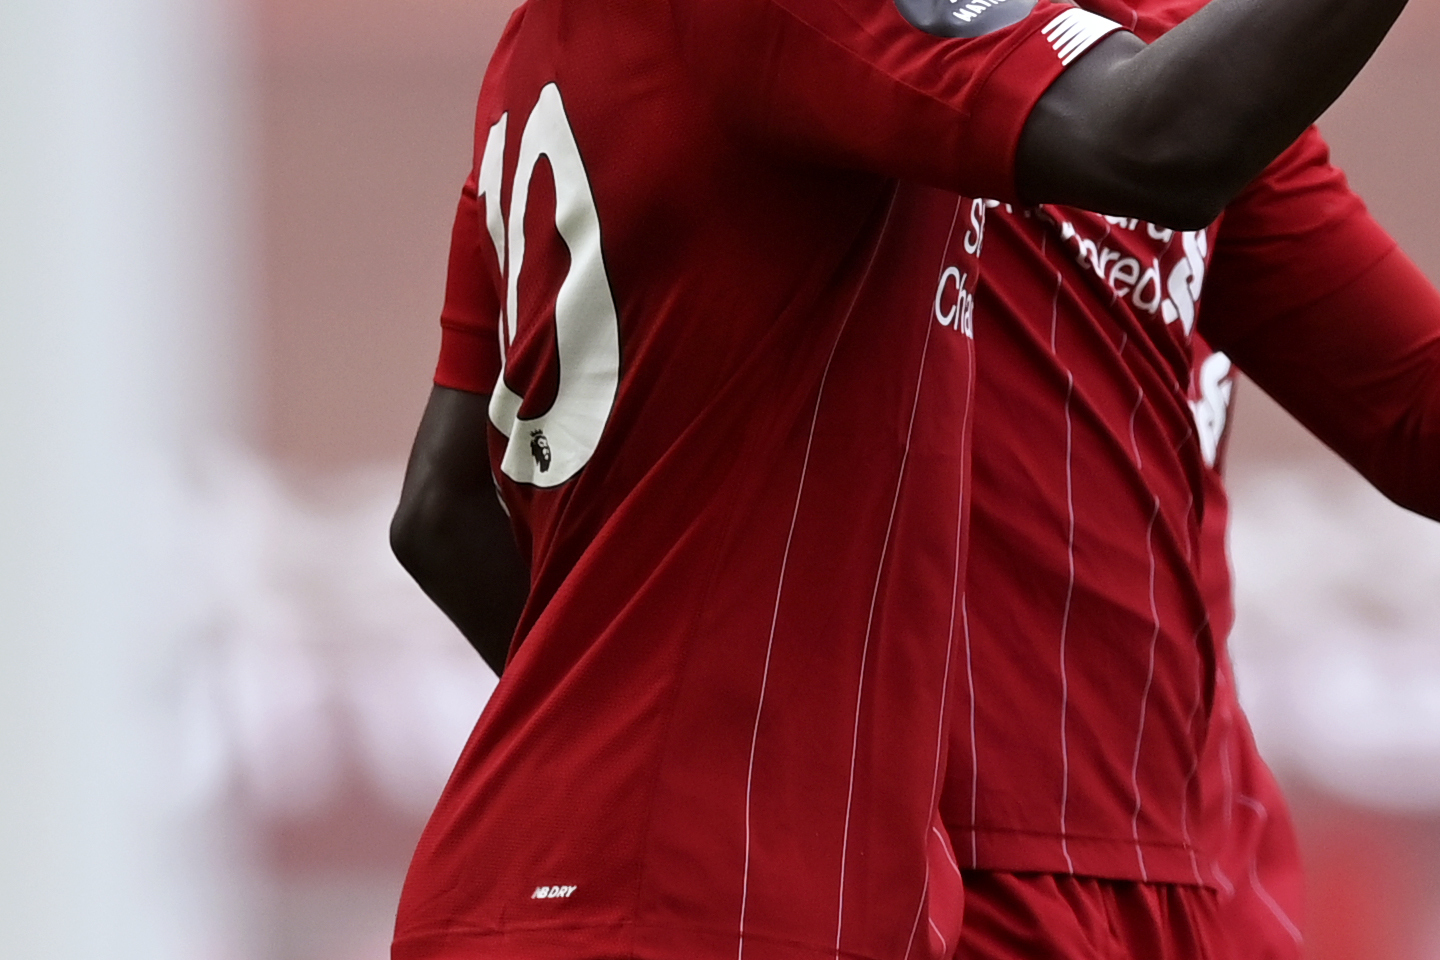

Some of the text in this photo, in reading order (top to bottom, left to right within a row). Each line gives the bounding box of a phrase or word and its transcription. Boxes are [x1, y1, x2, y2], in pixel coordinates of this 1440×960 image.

[478, 81, 620, 489] 10
[934, 266, 974, 340] Cha
[547, 885, 577, 898] DRY
